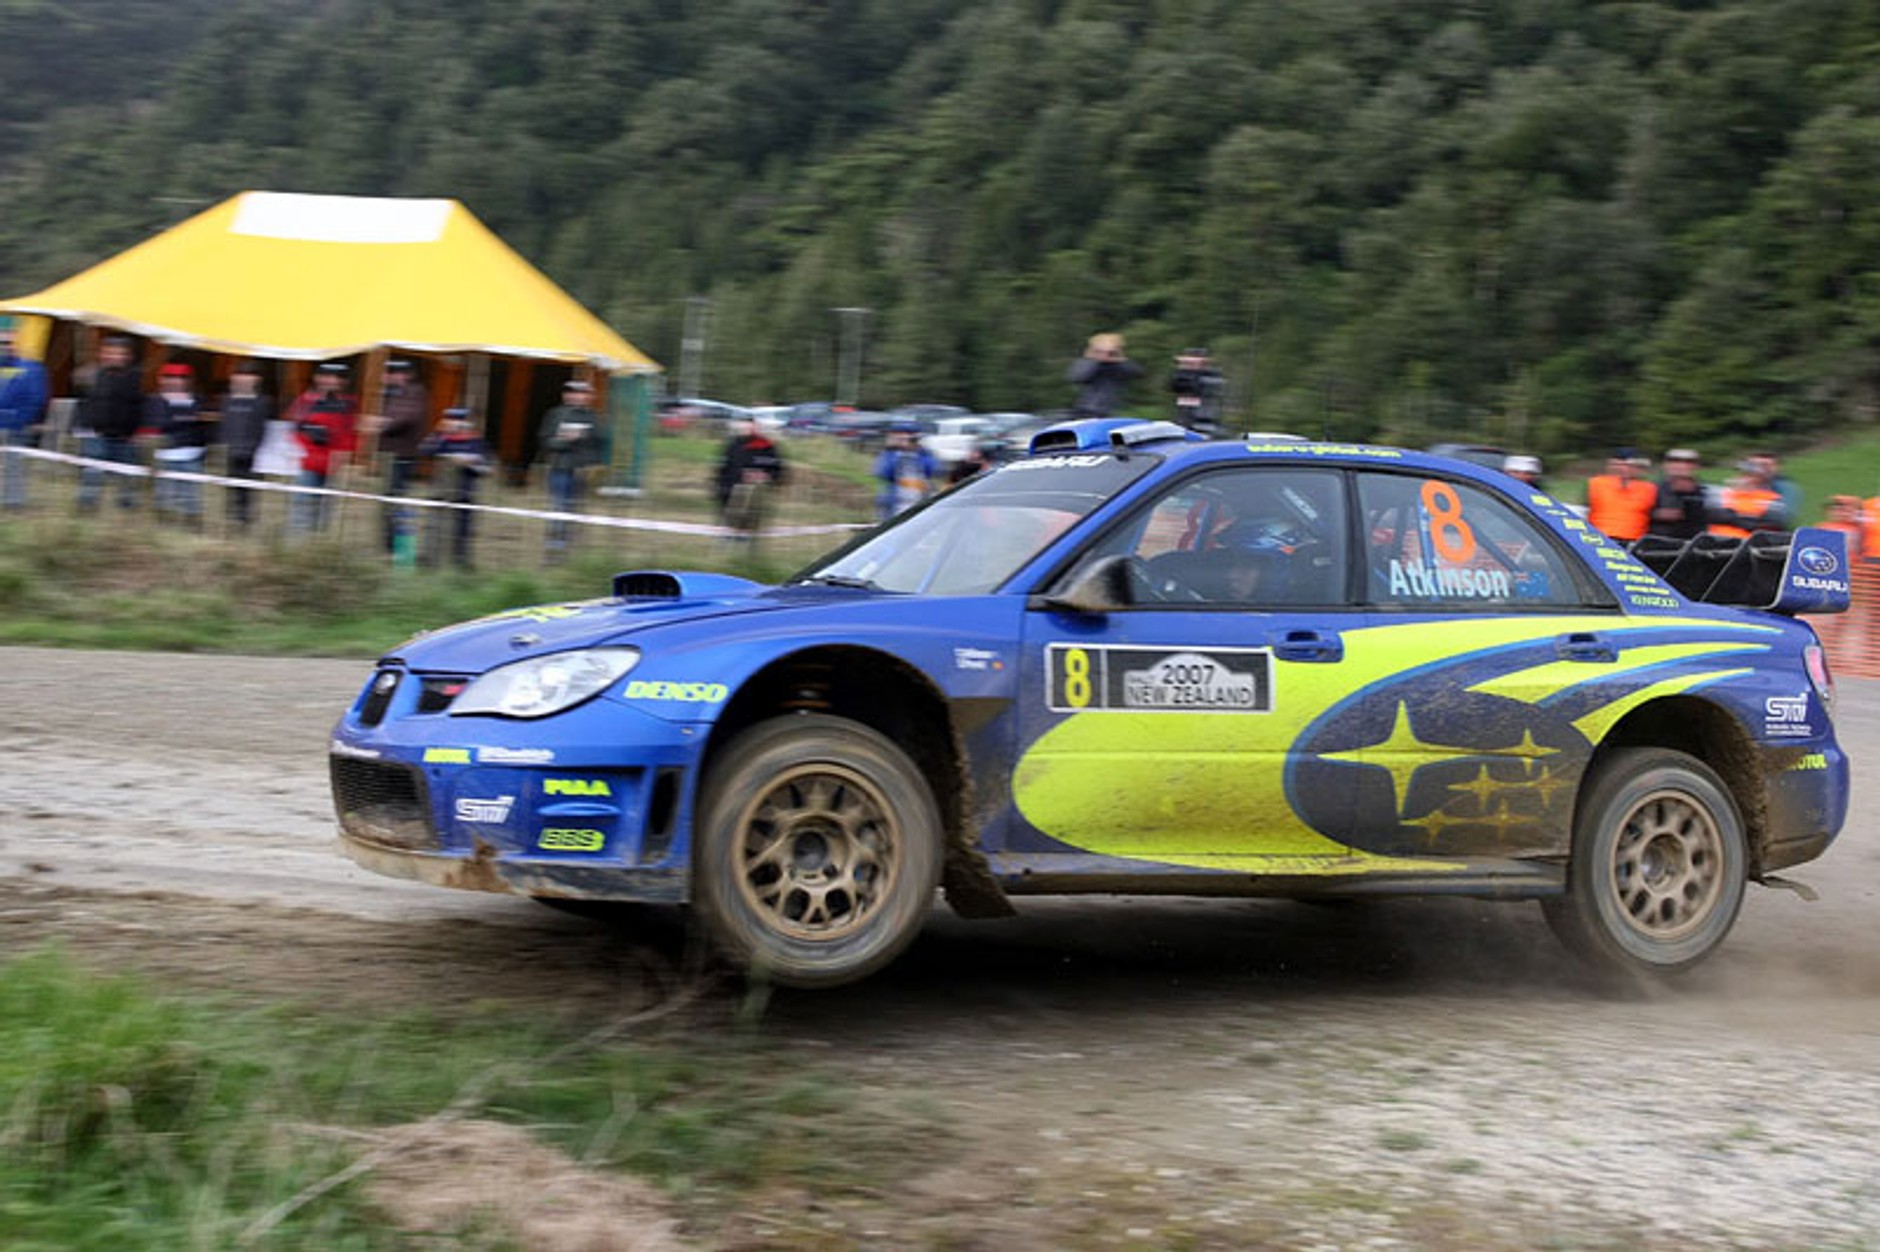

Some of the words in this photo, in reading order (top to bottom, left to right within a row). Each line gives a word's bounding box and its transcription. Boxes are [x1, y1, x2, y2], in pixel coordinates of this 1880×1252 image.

[1420, 479, 1477, 564] 8
[1390, 556, 1510, 598] Atkinson
[1792, 575, 1848, 592] SUBARU
[1064, 648, 1092, 708] 8
[1162, 664, 1215, 685] 2007
[623, 680, 728, 703] DENSO
[1128, 685, 1168, 703] NEW
[1172, 685, 1253, 704] ZEALAND
[543, 778, 612, 796] PIAA
